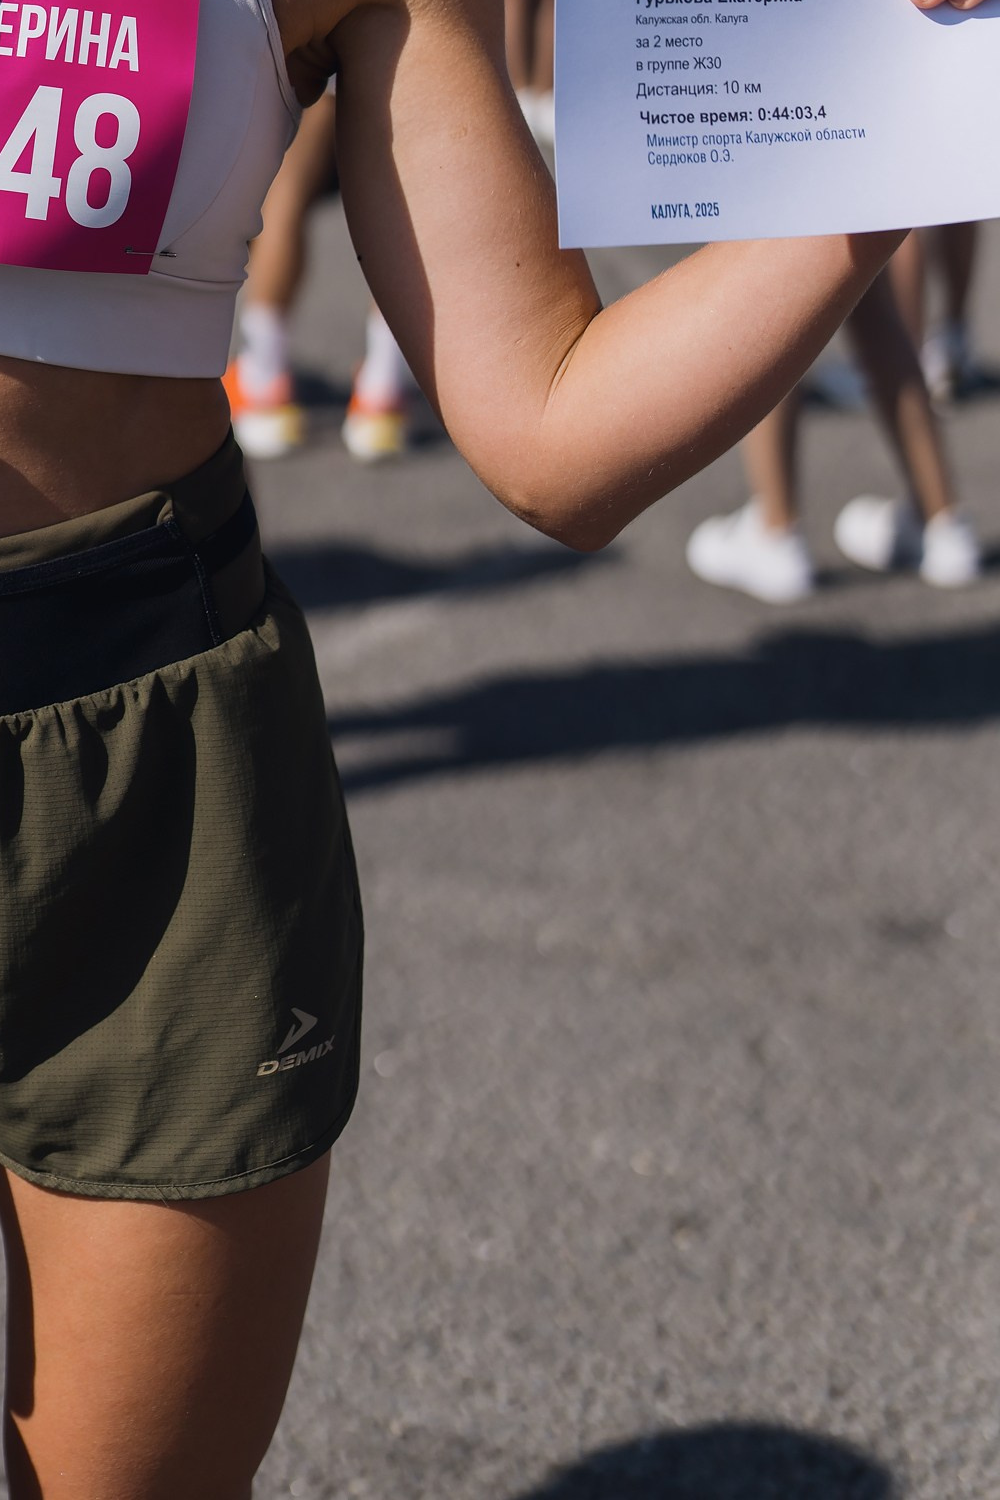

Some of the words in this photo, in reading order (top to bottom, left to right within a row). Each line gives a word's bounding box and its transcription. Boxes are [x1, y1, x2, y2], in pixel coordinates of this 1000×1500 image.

[635, 14, 688, 27] Калужская
[690, 12, 712, 24] обл.
[715, 13, 748, 25] Калуга
[636, 38, 650, 48] за
[653, 35, 661, 48] 2
[665, 37, 703, 47] место
[636, 61, 643, 71] в
[647, 60, 690, 73] группе
[693, 57, 722, 70] Ж30
[636, 83, 718, 99] Дистанция:
[723, 80, 739, 94] 10
[744, 83, 762, 94] км
[640, 110, 695, 125] Чистое
[700, 109, 753, 125] время:
[758, 105, 827, 121] 0:44:03,4
[646, 133, 699, 148] Министр
[702, 132, 743, 148] спорта
[746, 129, 812, 145] Калужской
[815, 127, 866, 141] области
[648, 150, 707, 167] Сердюков
[710, 149, 735, 163] О.Э.
[651, 204, 693, 219] КАЛУГА,
[695, 202, 720, 218] 2025
[257, 1035, 335, 1076] DEMIX
